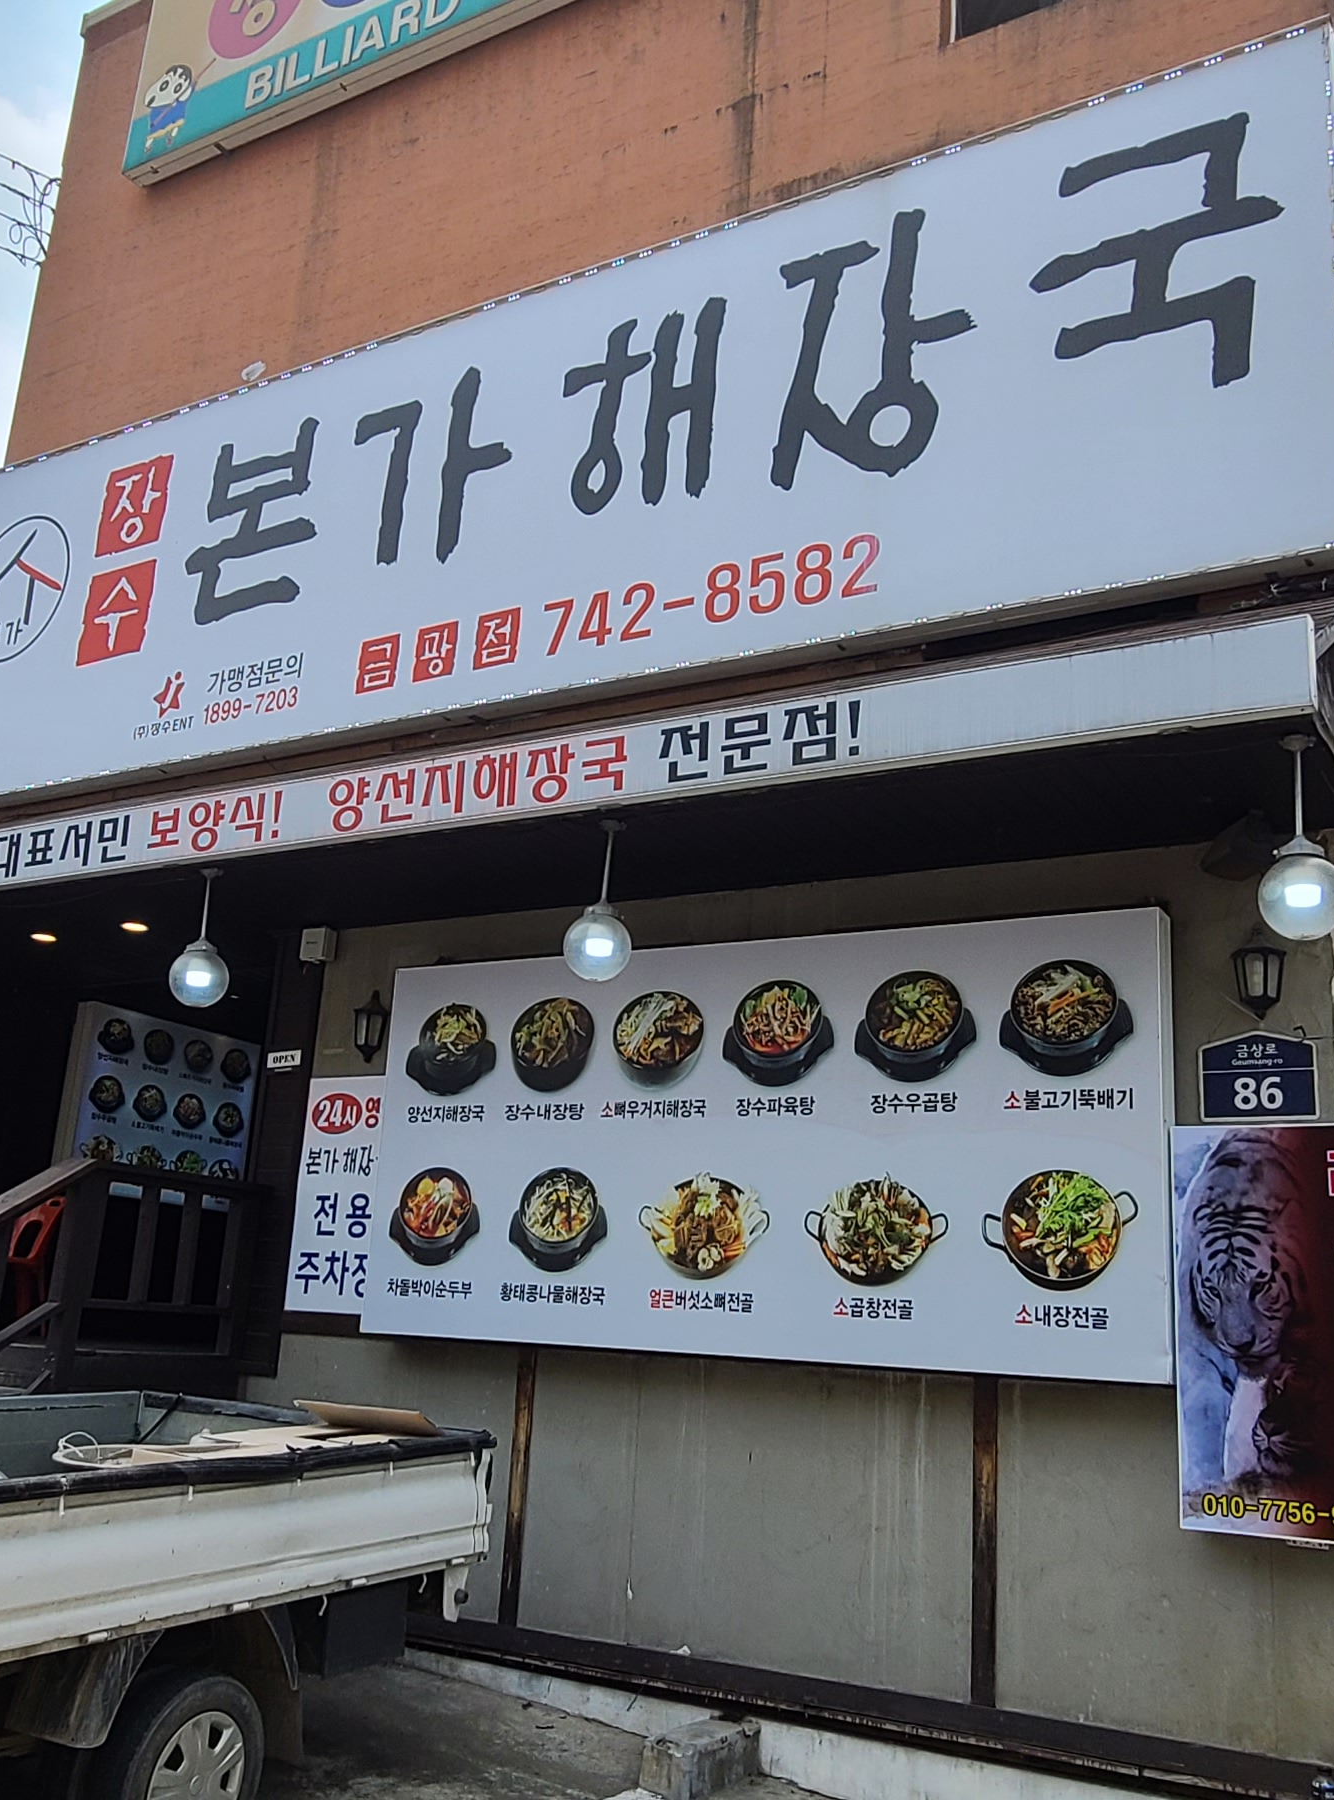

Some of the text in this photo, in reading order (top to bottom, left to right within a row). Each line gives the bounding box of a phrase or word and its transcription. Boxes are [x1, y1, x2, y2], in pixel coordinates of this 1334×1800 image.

[186, 112, 1284, 625] 본가 해장국
[360, 533, 880, 690] 금광점 742-8582
[206, 653, 304, 695] 가맹점문의
[202, 686, 299, 727] 1899-7203
[146, 791, 283, 854] 보양식!
[328, 735, 628, 833] 양선지해장국
[658, 700, 862, 784] 전문점!
[272, 1052, 297, 1066] OPEN
[1235, 1043, 1279, 1057] 금상로
[870, 1092, 958, 1115] 장수우곱탕
[1003, 1088, 1135, 1111] 소불고기뚝배기
[1233, 1076, 1284, 1110] 86
[317, 1099, 357, 1128] 24시
[407, 1104, 485, 1122] 양선지해장국
[504, 1102, 585, 1121] 장수내장탕
[601, 1098, 707, 1119] 소뼈우거지해장국
[735, 1095, 815, 1116] 장수파육탕
[305, 1144, 379, 1177] 본가 해장
[313, 1192, 372, 1239] 전용
[387, 1278, 473, 1299] 차돌박이순두부
[500, 1282, 606, 1306] 황태콩나물해장국
[649, 1289, 754, 1313] 얼큰버섯소뼈전골
[833, 1297, 914, 1321] 소곱창전골
[1014, 1304, 1110, 1330] 소내장전골
